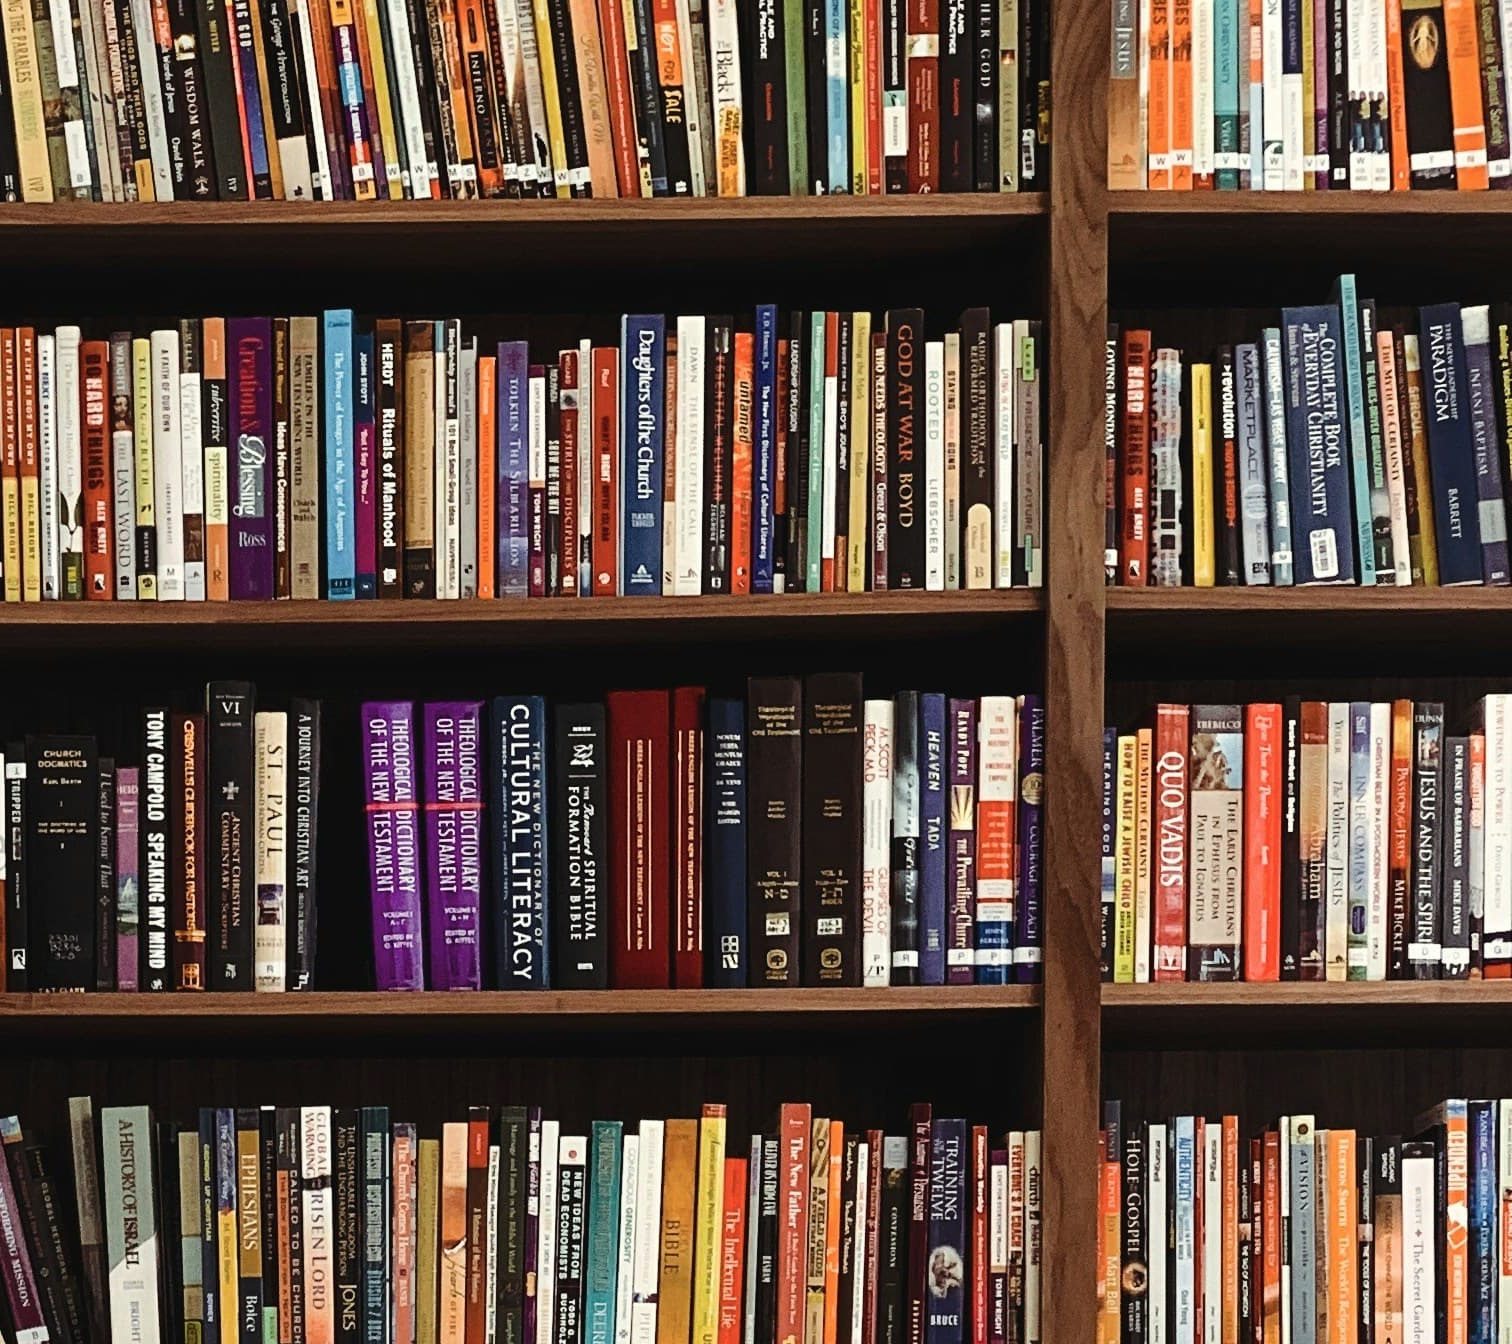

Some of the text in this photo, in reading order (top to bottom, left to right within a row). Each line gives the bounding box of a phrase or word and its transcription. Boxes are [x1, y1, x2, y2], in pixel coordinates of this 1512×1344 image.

[121, 6, 147, 150] THE KINGS AND THEIR GODS
[183, 67, 205, 168] WISDOM WALK
[470, 54, 485, 114] INFERNO
[661, 24, 681, 123] NOT FOR SALE
[633, 330, 655, 408] Daughters
[1430, 324, 1447, 422] PARADIGM
[382, 344, 395, 547] HERDT Rituals of Manhood
[637, 445, 654, 499] Church
[897, 325, 913, 527] GOD AT WAR BOYD
[928, 370, 939, 554] ROOTED LIEBSCHER
[1448, 488, 1461, 539] BARRETT
[147, 711, 165, 968] TONY CAMPOLO SPEAKING MY MIND
[369, 718, 393, 893] OF THE NEW TESTAMENT
[391, 718, 415, 892] THEOLOGICAL DICTIONARY
[437, 718, 456, 892] OF THE NEW TESTAMENT
[458, 718, 478, 892] THEOLOGICAL DICTIONARY
[511, 705, 532, 979] CULTURAL LITERACY
[1156, 751, 1184, 887] QUO VADIS
[119, 1120, 139, 1269] A HISTORY OF ISRAEL
[242, 1154, 257, 1250] EPHESIANS
[559, 1170, 570, 1279] DEAD ECONOMISTS
[571, 1172, 582, 1278] NEW IDEAS FROM
[788, 1137, 802, 1228] The New Father
[11, 1259, 30, 1307] MISSION
[1413, 1242, 1423, 1265] The
[1413, 1267, 1423, 1301] Secret
